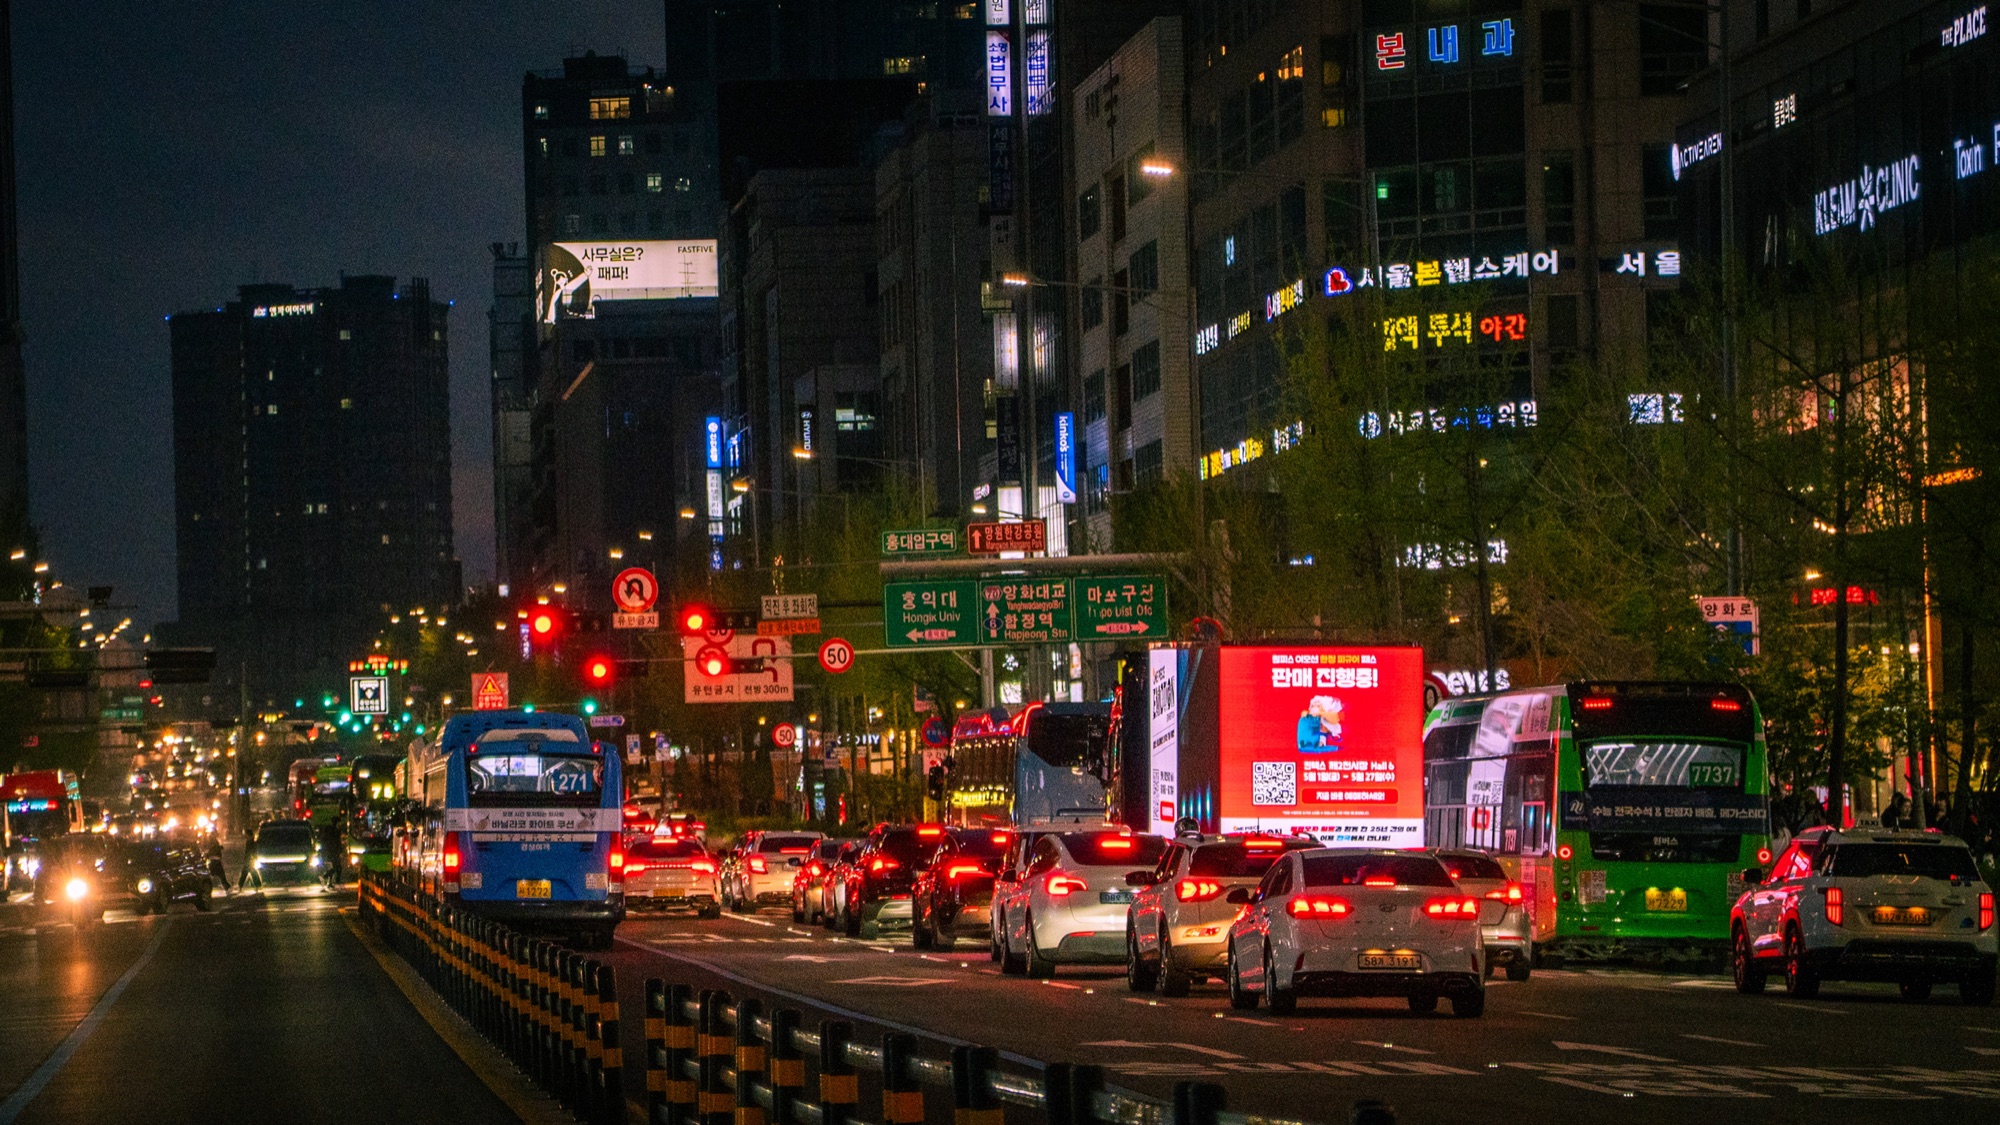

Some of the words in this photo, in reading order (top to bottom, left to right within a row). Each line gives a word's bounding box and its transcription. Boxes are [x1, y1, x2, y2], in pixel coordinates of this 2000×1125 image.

[1941, 26, 1953, 47] THE
[1953, 6, 1987, 47] PLACE
[988, 42, 1008, 53] 소명
[989, 55, 1008, 112] 법무사
[1954, 133, 1984, 180] Toxin
[1875, 153, 1920, 214] CLINIC
[582, 247, 644, 263] 사무실은?
[677, 245, 714, 254] FASTFIVE
[597, 266, 629, 281] 패파!
[1480, 313, 1527, 342] 야간
[803, 419, 812, 451] HYUND
[1058, 415, 1070, 453] kinko's
[985, 524, 1043, 541] 망원한강공원
[886, 532, 954, 551] 홍대입구역
[902, 590, 957, 610] 홍익대
[1002, 584, 1066, 601] 양화대교
[765, 598, 780, 616] 직진
[1704, 602, 1752, 617] 양화로
[617, 614, 656, 627] 유턴금지
[903, 612, 937, 625] Hongik
[939, 611, 961, 622] Univ
[1004, 613, 1053, 629] 합정역
[1004, 629, 1048, 641] Hapjeong
[1051, 628, 1068, 638] Stn
[827, 647, 847, 664] 50
[1271, 667, 1313, 688] 판매
[1316, 667, 1378, 688] 진행중!
[692, 684, 734, 695] 유턴금지
[743, 684, 761, 695] 전방
[763, 684, 789, 695] 300m
[779, 729, 792, 742] 50
[1371, 761, 1387, 771] Hall
[1388, 762, 1395, 771] 6
[1692, 765, 1733, 784] 7737
[559, 773, 587, 791] 271
[491, 819, 526, 829] 바닐라코
[529, 819, 554, 829] 화이트
[557, 819, 574, 829] 쿠션
[1389, 956, 1415, 967] 3191
